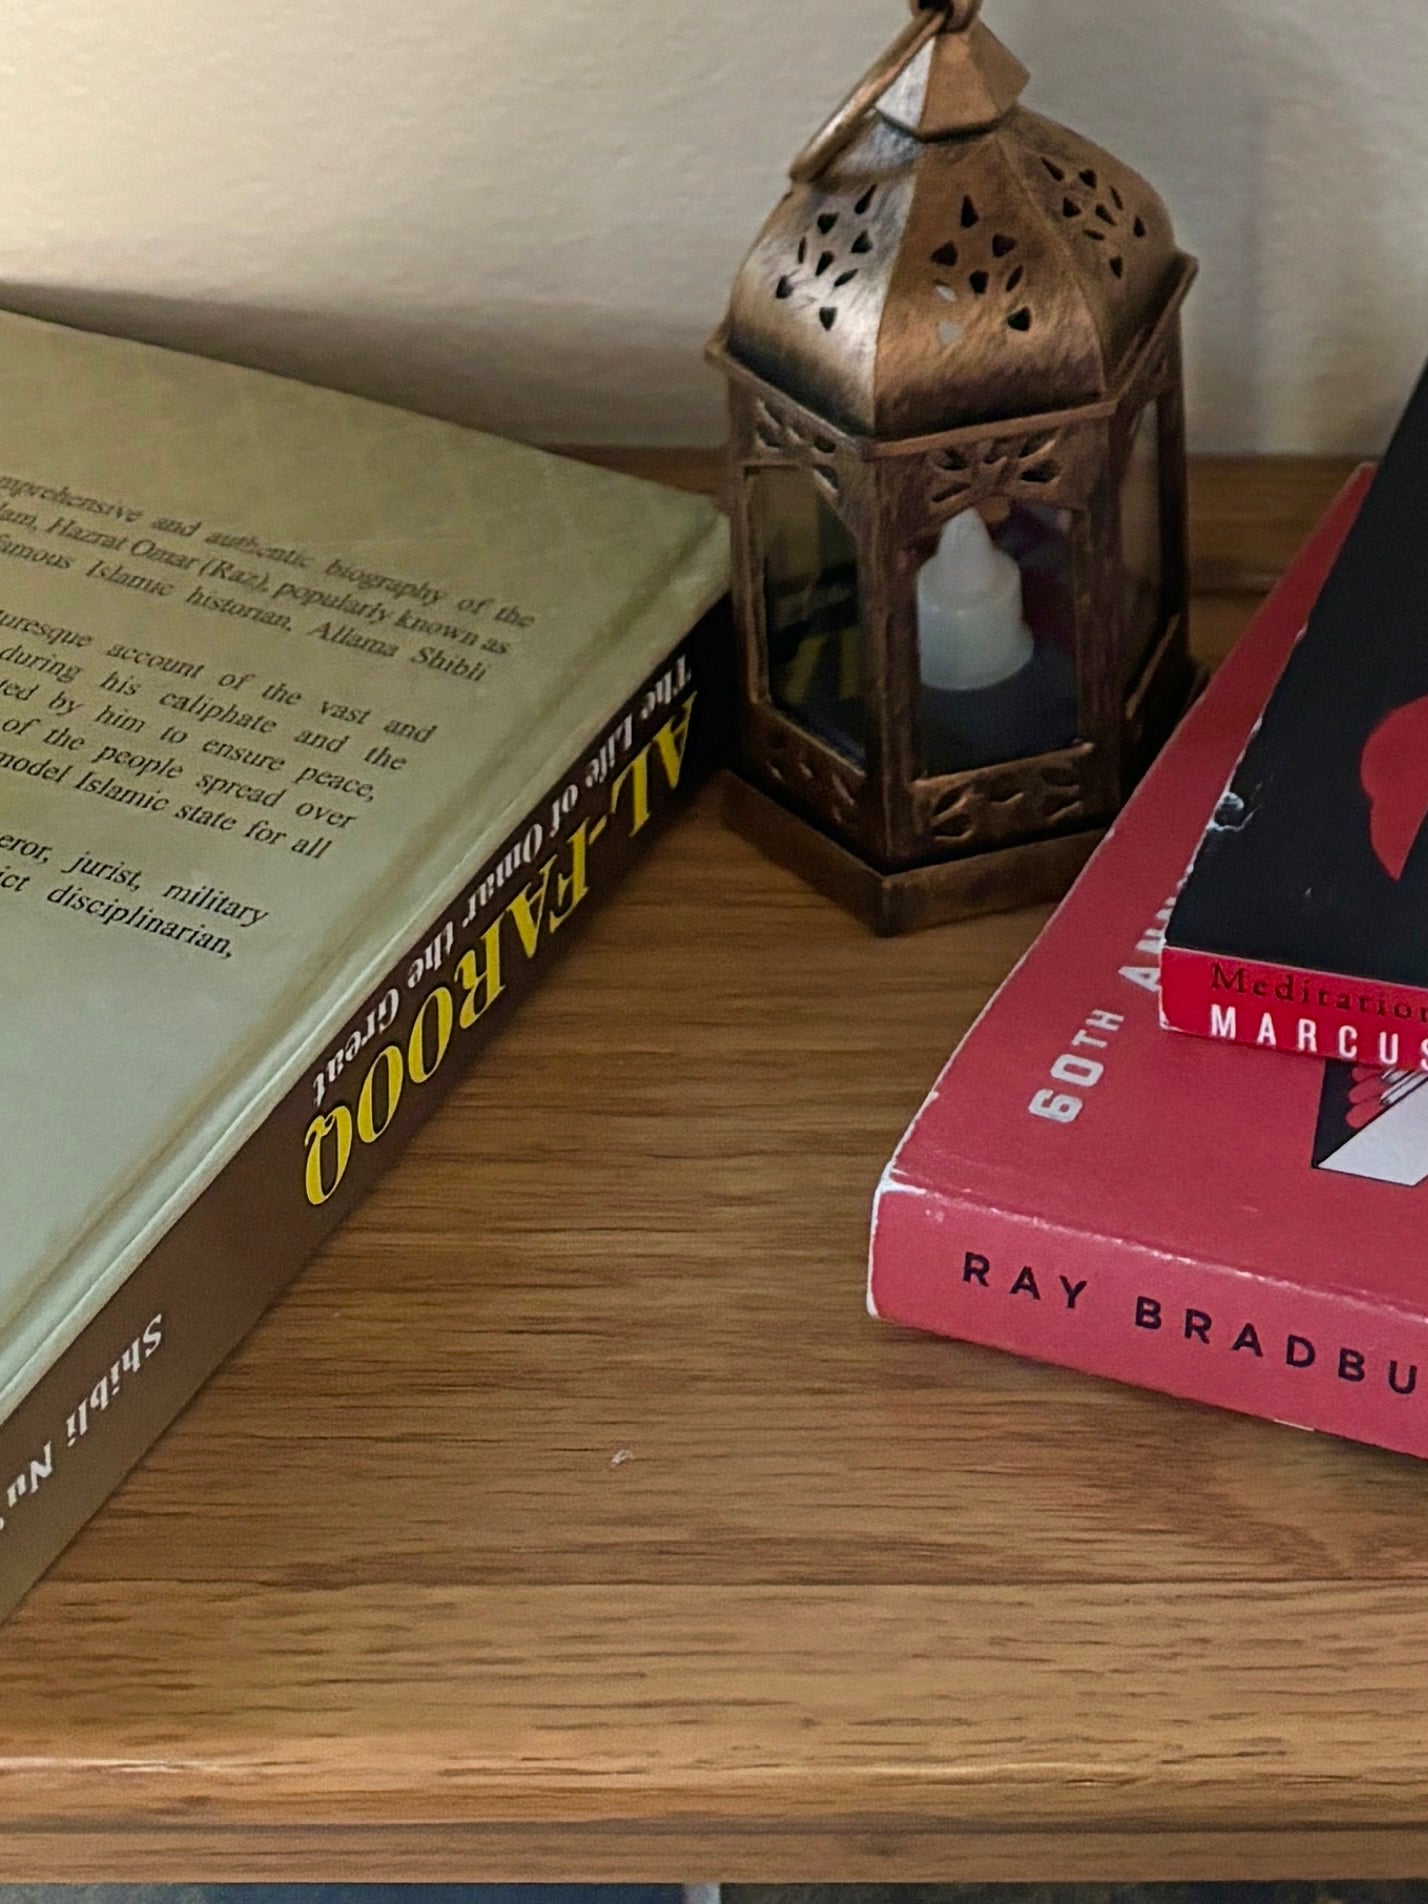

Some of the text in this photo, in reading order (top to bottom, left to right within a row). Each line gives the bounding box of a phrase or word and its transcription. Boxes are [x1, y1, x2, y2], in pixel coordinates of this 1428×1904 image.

[46, 517, 128, 551] Hazrat
[130, 539, 201, 570] Omar
[272, 582, 393, 624] popularly
[394, 609, 479, 647] known
[480, 638, 511, 655] as
[85, 559, 175, 596] Islamic
[307, 622, 400, 657] Allama
[410, 645, 491, 682] Shibli
[152, 521, 202, 537] and
[205, 531, 314, 568] authentic
[324, 559, 446, 607] biography
[457, 597, 496, 615] of
[494, 605, 536, 628] the
[0, 644, 407, 770] during his caliphate and the
[48, 691, 84, 716] by
[94, 705, 146, 733] him
[159, 726, 188, 743] to
[202, 739, 286, 772] ensure
[293, 766, 374, 803] peace,
[107, 643, 204, 679] account
[218, 673, 256, 690] of
[261, 683, 302, 705] the
[319, 700, 371, 724] vast
[383, 719, 438, 743] and
[1, 718, 357, 829] of the people spread over
[75, 771, 170, 812] Islamic
[174, 805, 237, 831] state
[243, 820, 287, 845] for
[292, 837, 333, 859] all
[46, 884, 233, 960] disciplinarian,
[61, 850, 144, 891] jurist,
[162, 884, 269, 928] military
[312, 654, 692, 1107] The Life of Omar the Great
[1028, 1008, 1125, 1123] 60TH
[962, 1251, 1088, 1309] RAY
[66, 1313, 162, 1447] Shibli
